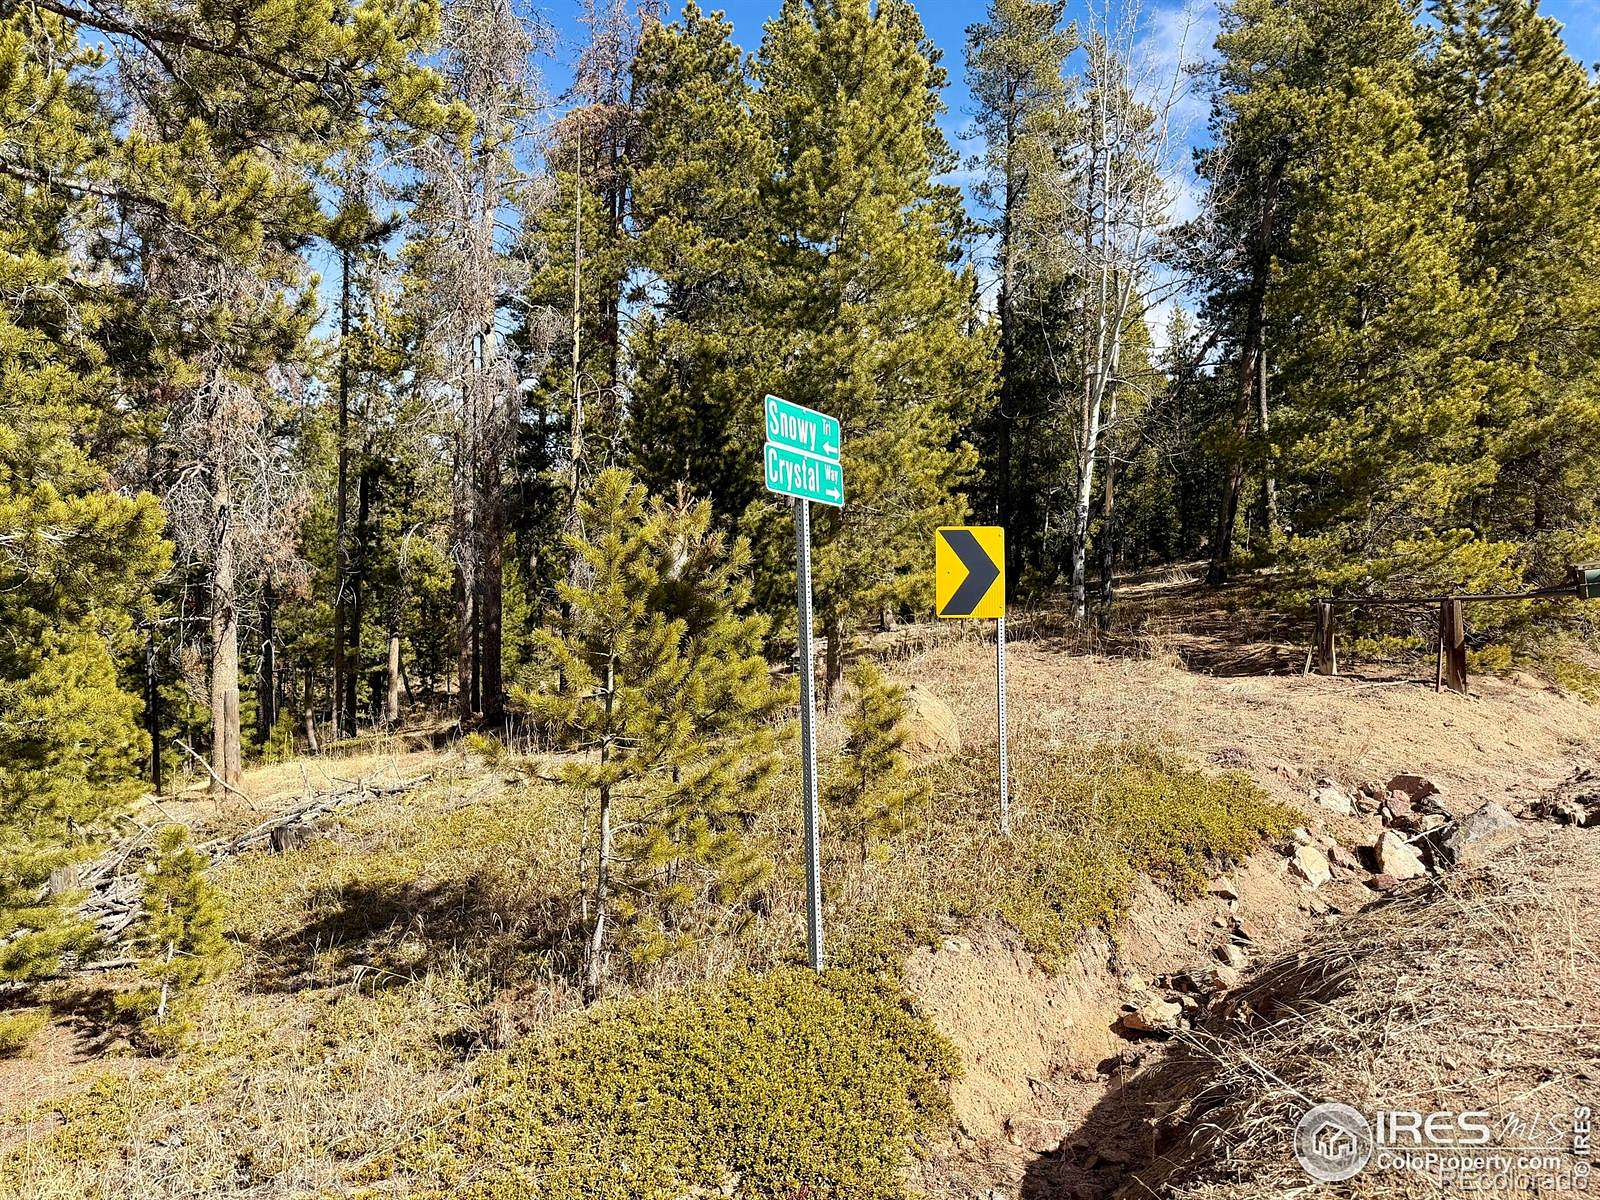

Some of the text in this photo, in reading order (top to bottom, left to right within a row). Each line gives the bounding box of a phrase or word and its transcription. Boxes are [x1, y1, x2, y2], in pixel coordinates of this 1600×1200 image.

[768, 400, 817, 452] Snowy
[768, 447, 839, 493] Crystal Way
